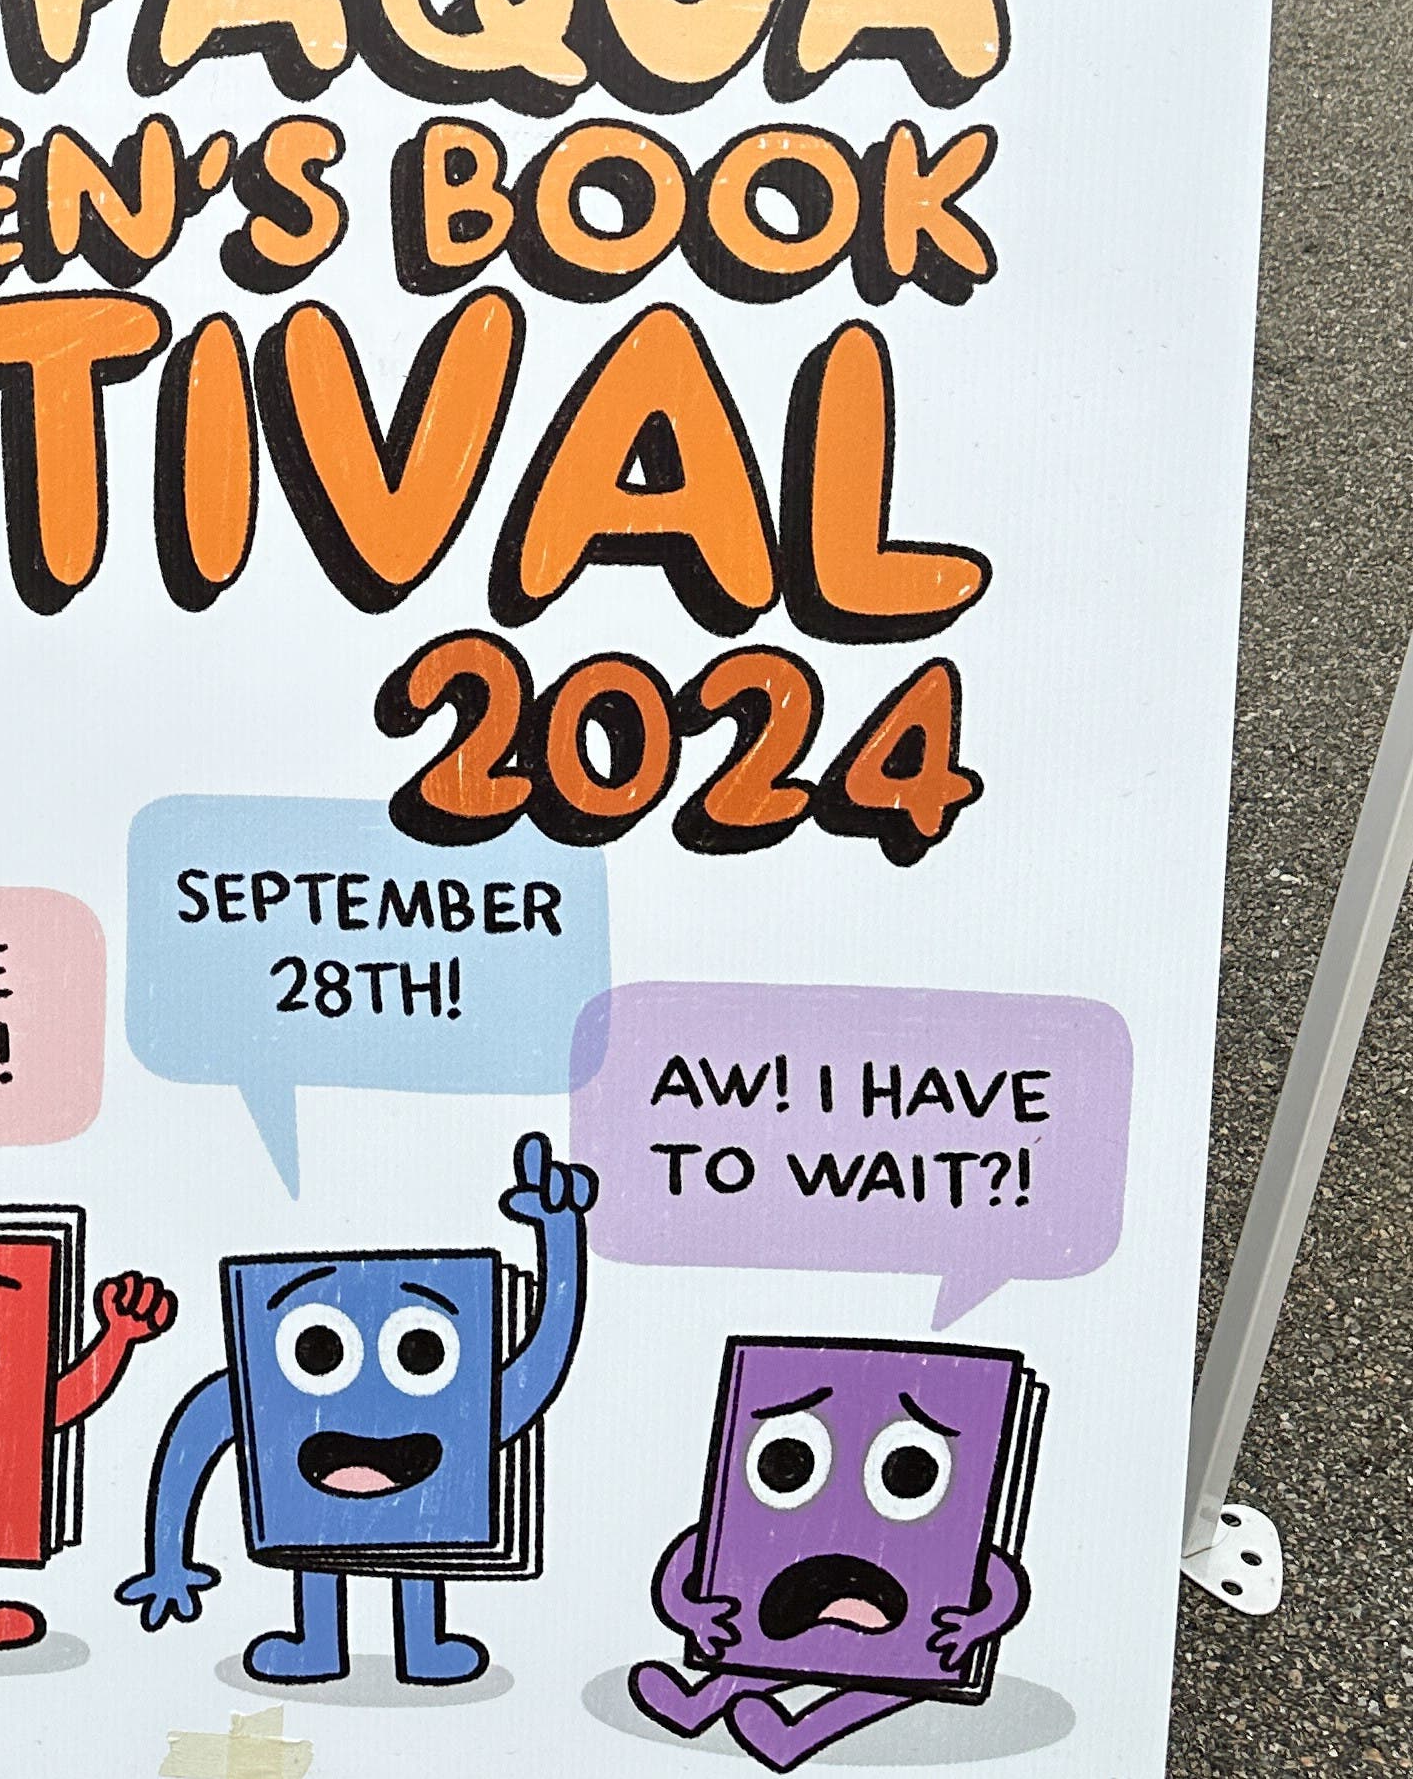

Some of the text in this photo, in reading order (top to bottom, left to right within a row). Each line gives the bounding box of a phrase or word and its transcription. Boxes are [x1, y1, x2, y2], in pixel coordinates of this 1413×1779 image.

[391, 115, 998, 305] BOOK
[375, 629, 983, 866] 2024
[176, 867, 563, 938] SEPTEMBER
[269, 954, 463, 1022] 28TH!
[649, 1053, 1052, 1124] AW! I HAVE
[648, 1142, 1031, 1210] TO WAIT?!
